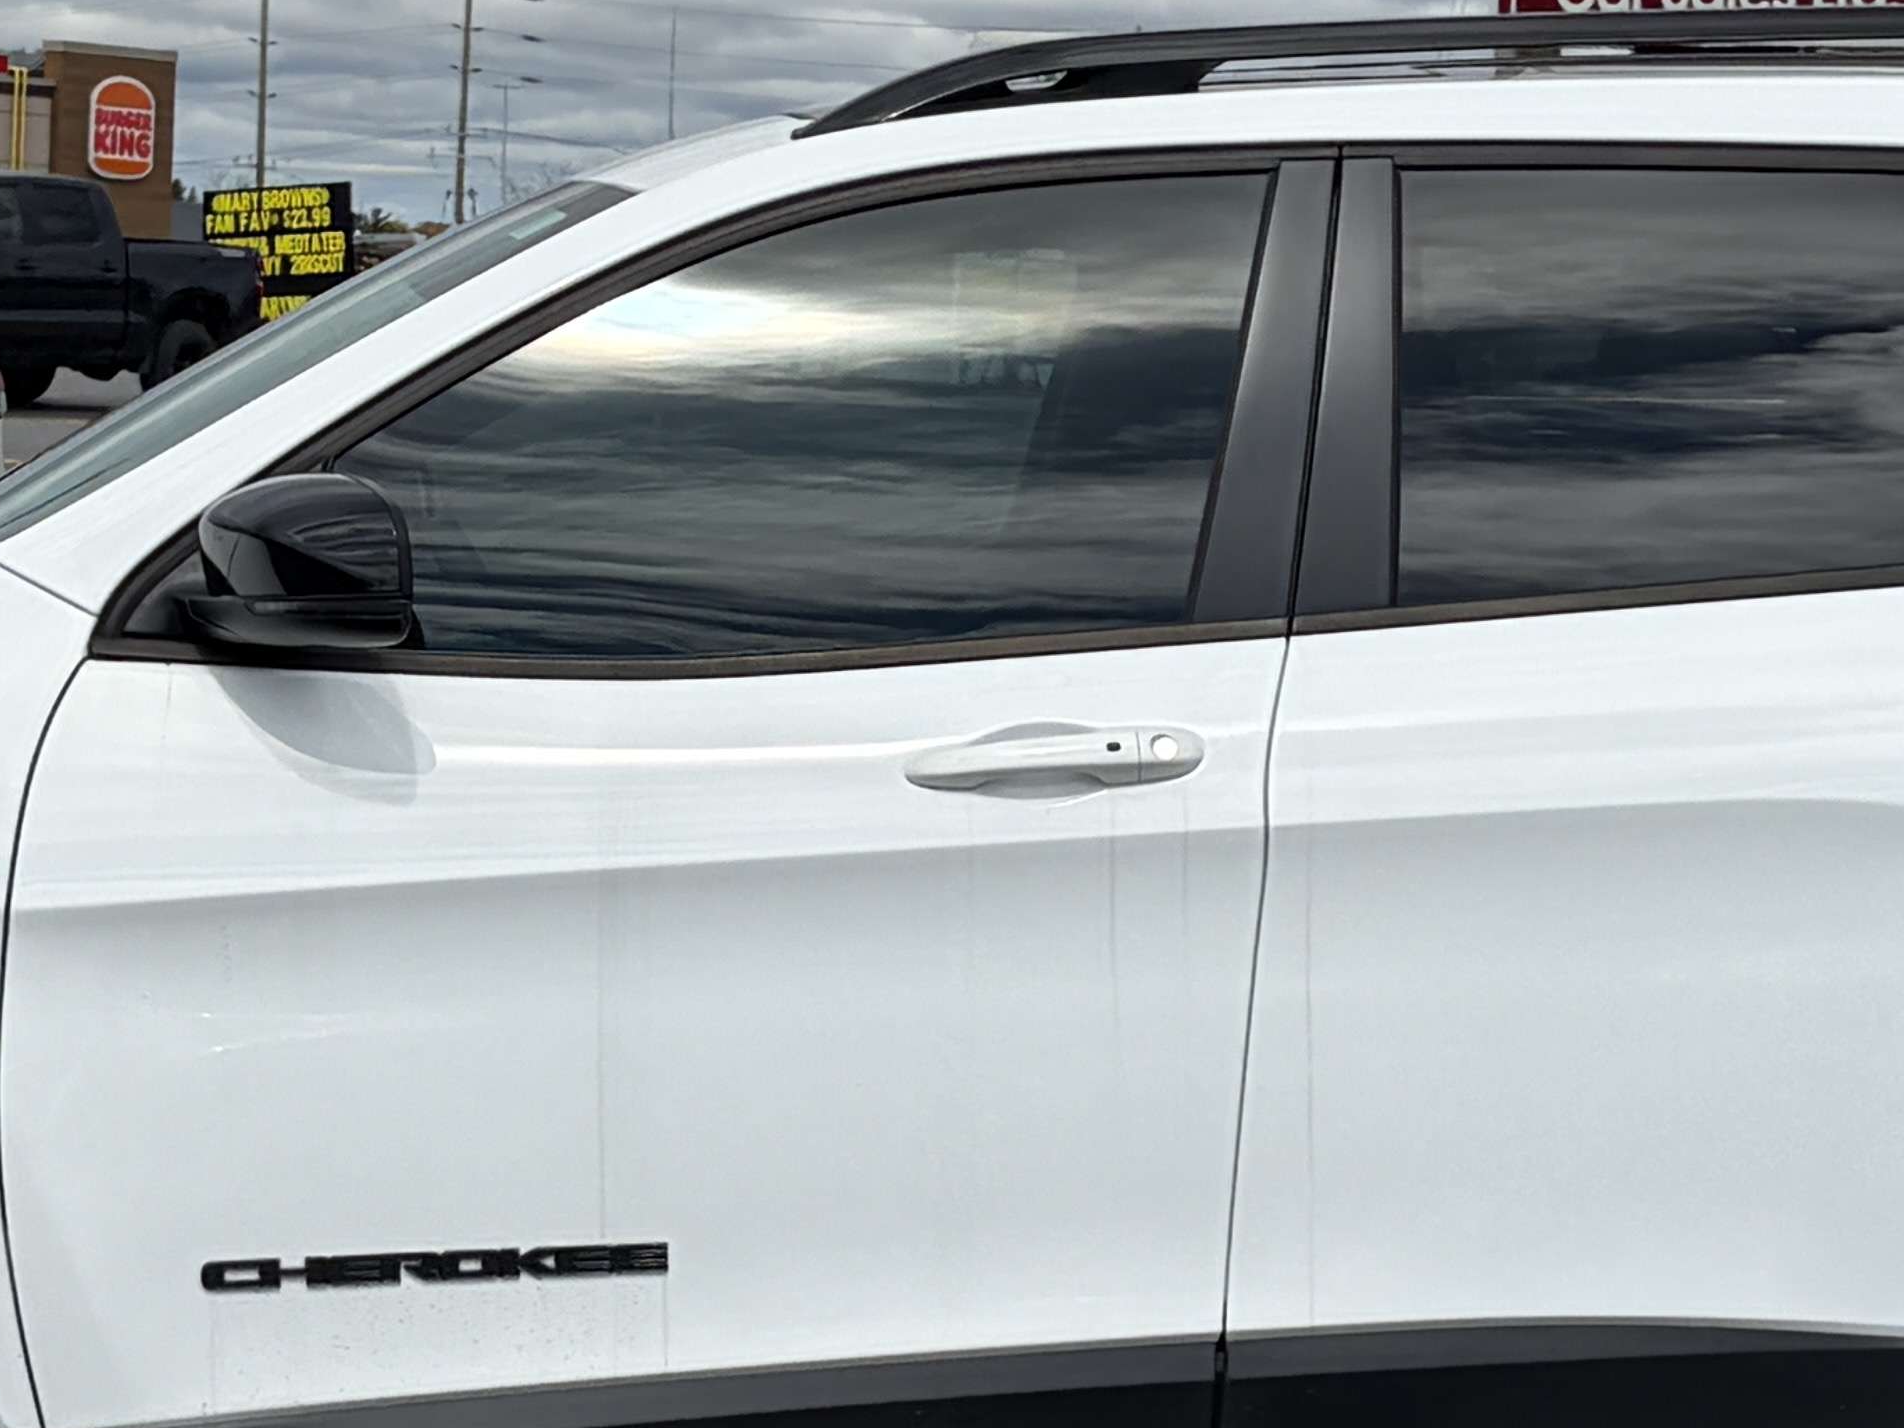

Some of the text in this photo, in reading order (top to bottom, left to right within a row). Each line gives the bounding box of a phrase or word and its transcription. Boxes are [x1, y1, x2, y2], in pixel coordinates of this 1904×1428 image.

[95, 107, 152, 131] BURGER
[95, 128, 151, 159] KING
[205, 214, 235, 235] FAN
[200, 1241, 669, 1293] CHEROKEE
